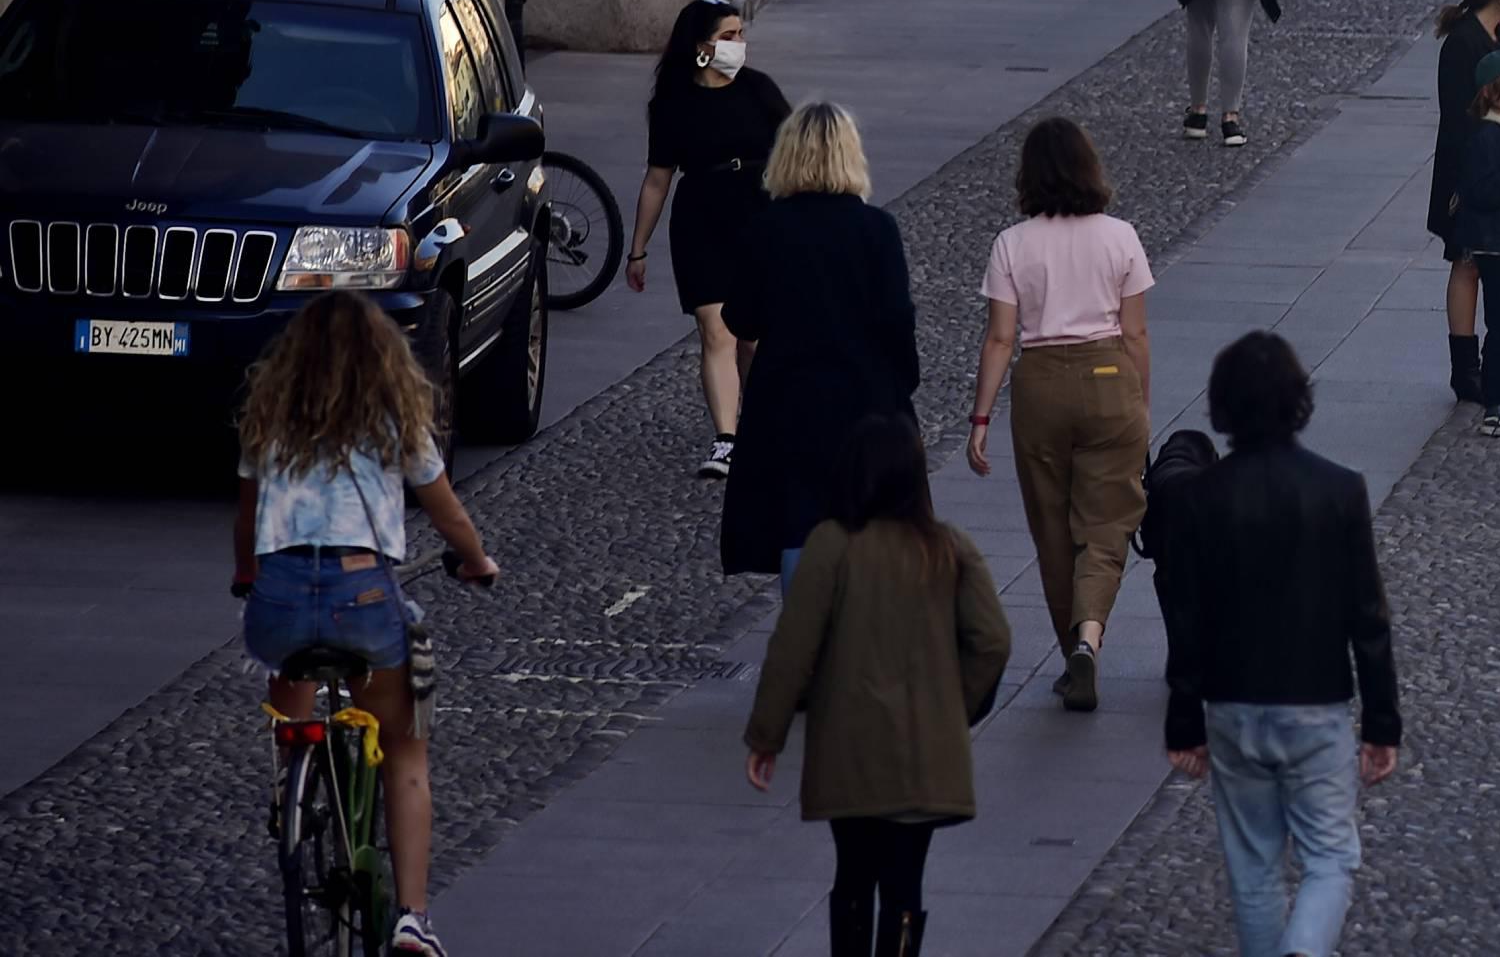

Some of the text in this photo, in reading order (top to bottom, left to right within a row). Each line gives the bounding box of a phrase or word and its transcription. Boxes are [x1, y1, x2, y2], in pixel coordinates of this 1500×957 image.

[125, 198, 168, 215] Jeep
[91, 326, 113, 348] BY
[118, 327, 173, 349] 425MN
